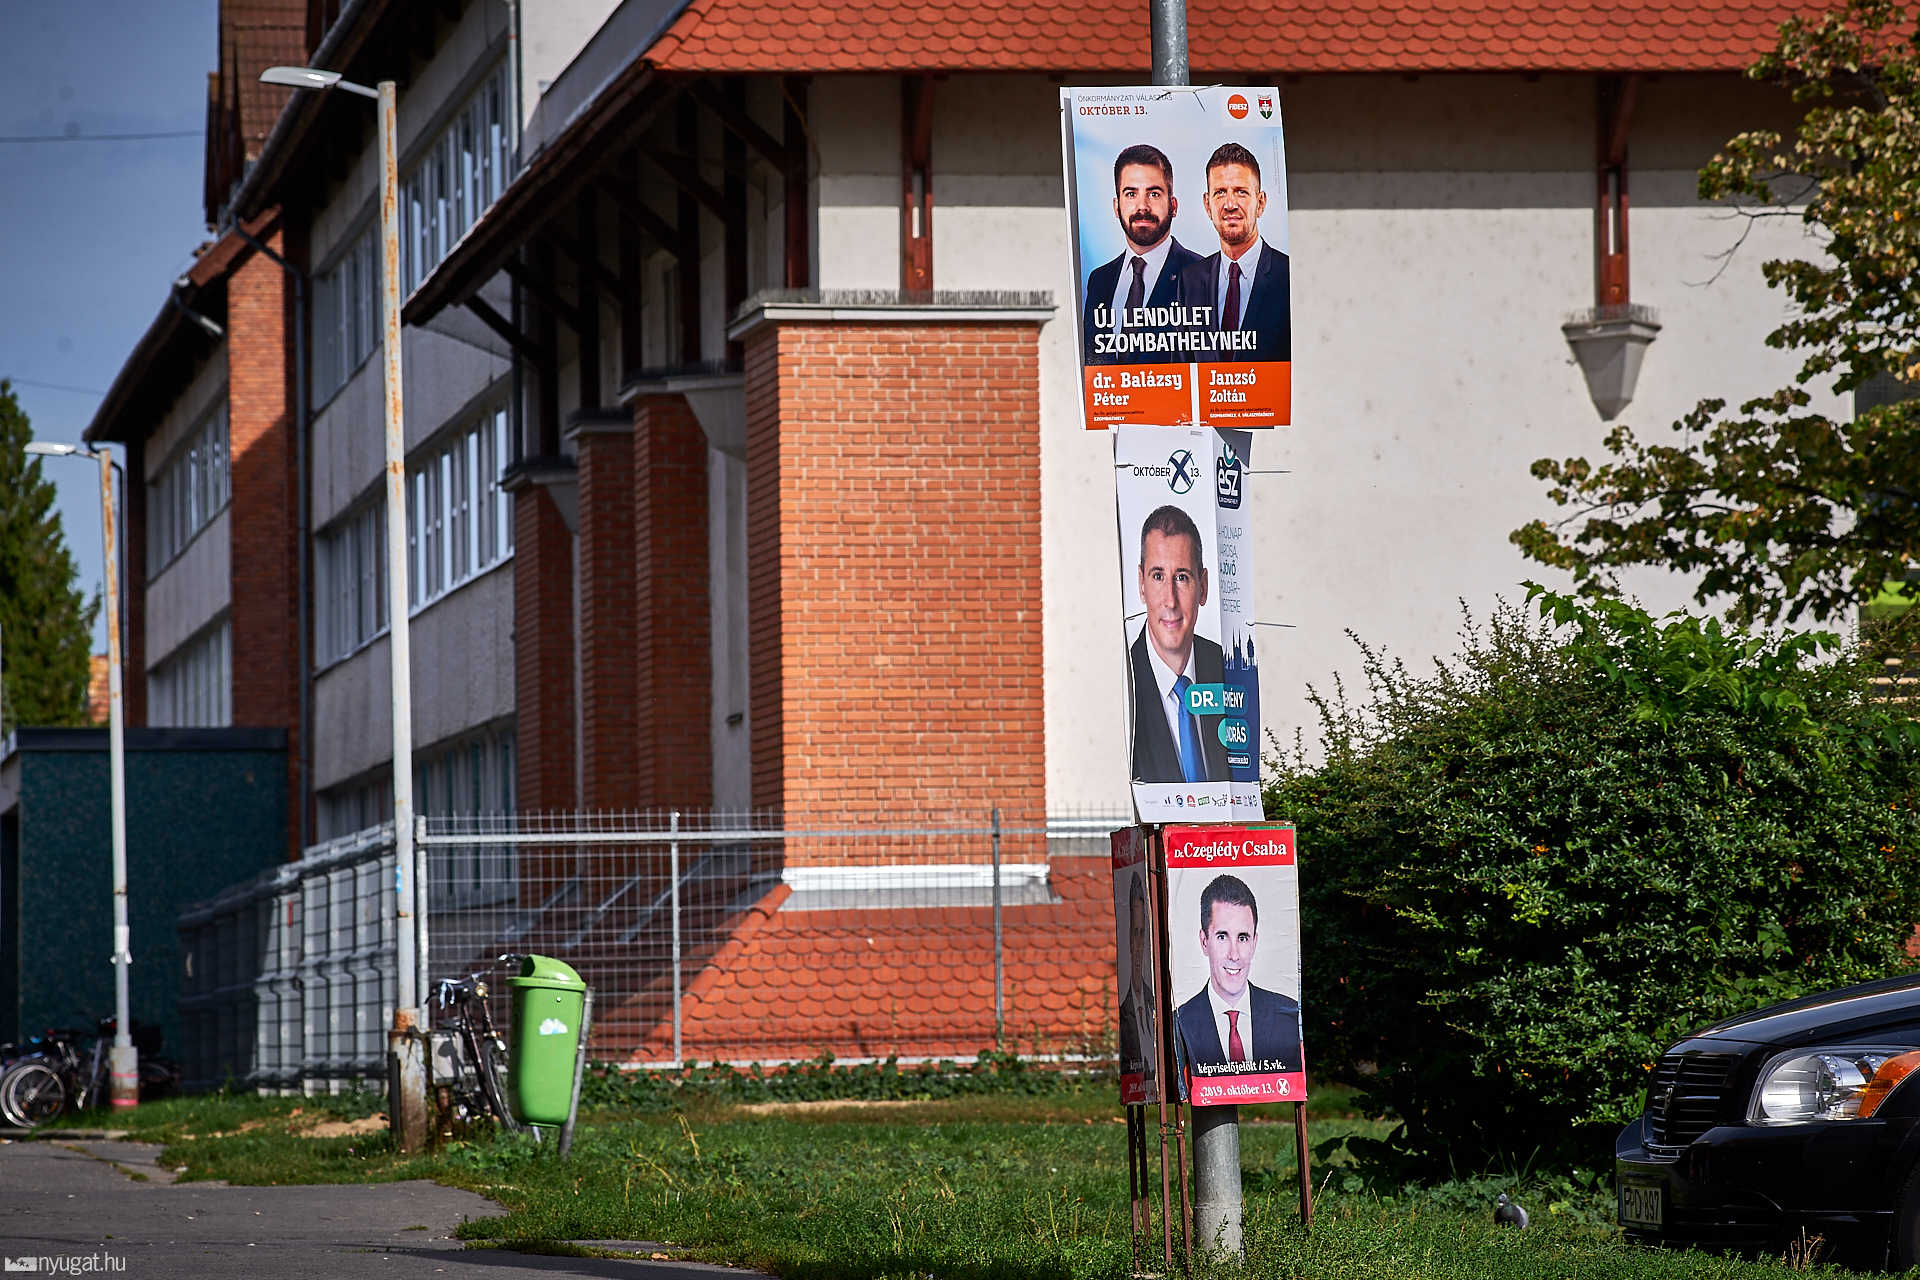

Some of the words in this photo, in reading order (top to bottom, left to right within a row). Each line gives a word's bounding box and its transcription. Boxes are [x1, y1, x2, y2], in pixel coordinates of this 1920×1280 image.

[1080, 104, 1130, 115] OKTÓBER
[1135, 106, 1148, 115] 13.
[1093, 303, 1115, 328] ÚJ
[1122, 302, 1212, 327] LENDÜLET
[1094, 330, 1257, 353] SZOMBATHELYNEK!
[1093, 373, 1115, 388] dr.
[1120, 371, 1182, 390] Balázsy
[1209, 369, 1256, 386] Janzsó
[1093, 393, 1130, 406] Péter
[1209, 390, 1246, 402] Zoltán
[1133, 465, 1171, 477] OKTÓBER
[1190, 467, 1202, 477] 13.
[1190, 690, 1219, 708] DR.
[1184, 841, 1240, 861] Czeglédy
[1242, 840, 1287, 857] Csaba
[1262, 1083, 1275, 1094] 13.
